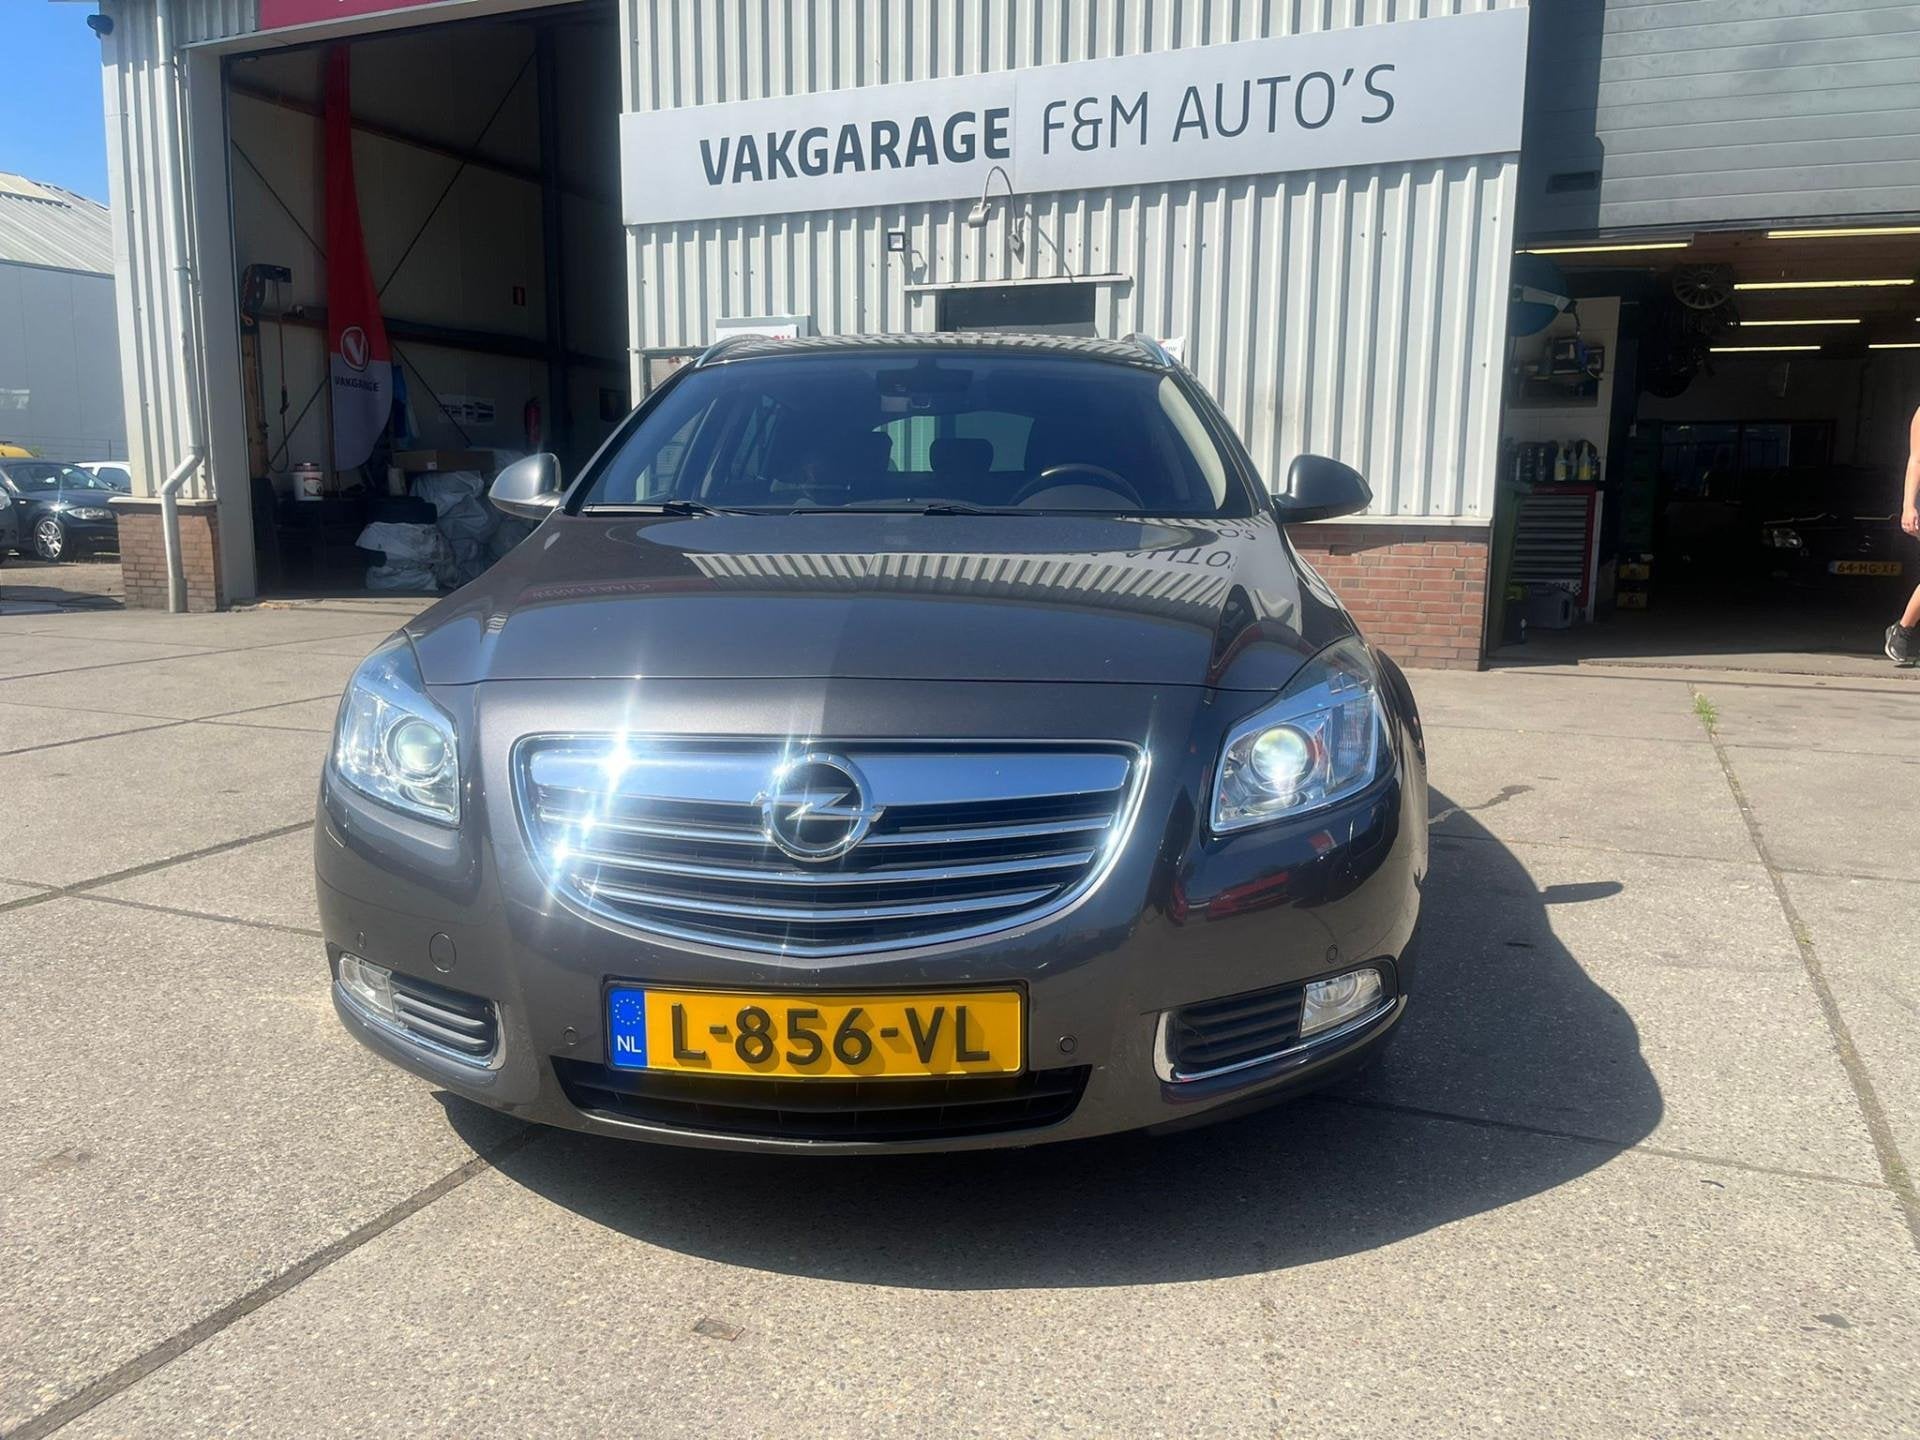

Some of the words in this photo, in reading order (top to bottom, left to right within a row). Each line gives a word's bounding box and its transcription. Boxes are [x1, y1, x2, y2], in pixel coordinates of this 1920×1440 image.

[700, 107, 1010, 186] VAKGARAGE
[1043, 91, 1149, 155] F&M
[1172, 63, 1396, 143] AUTO'S
[616, 1035, 642, 1054] NL
[671, 1003, 990, 1066] L-856-VL
